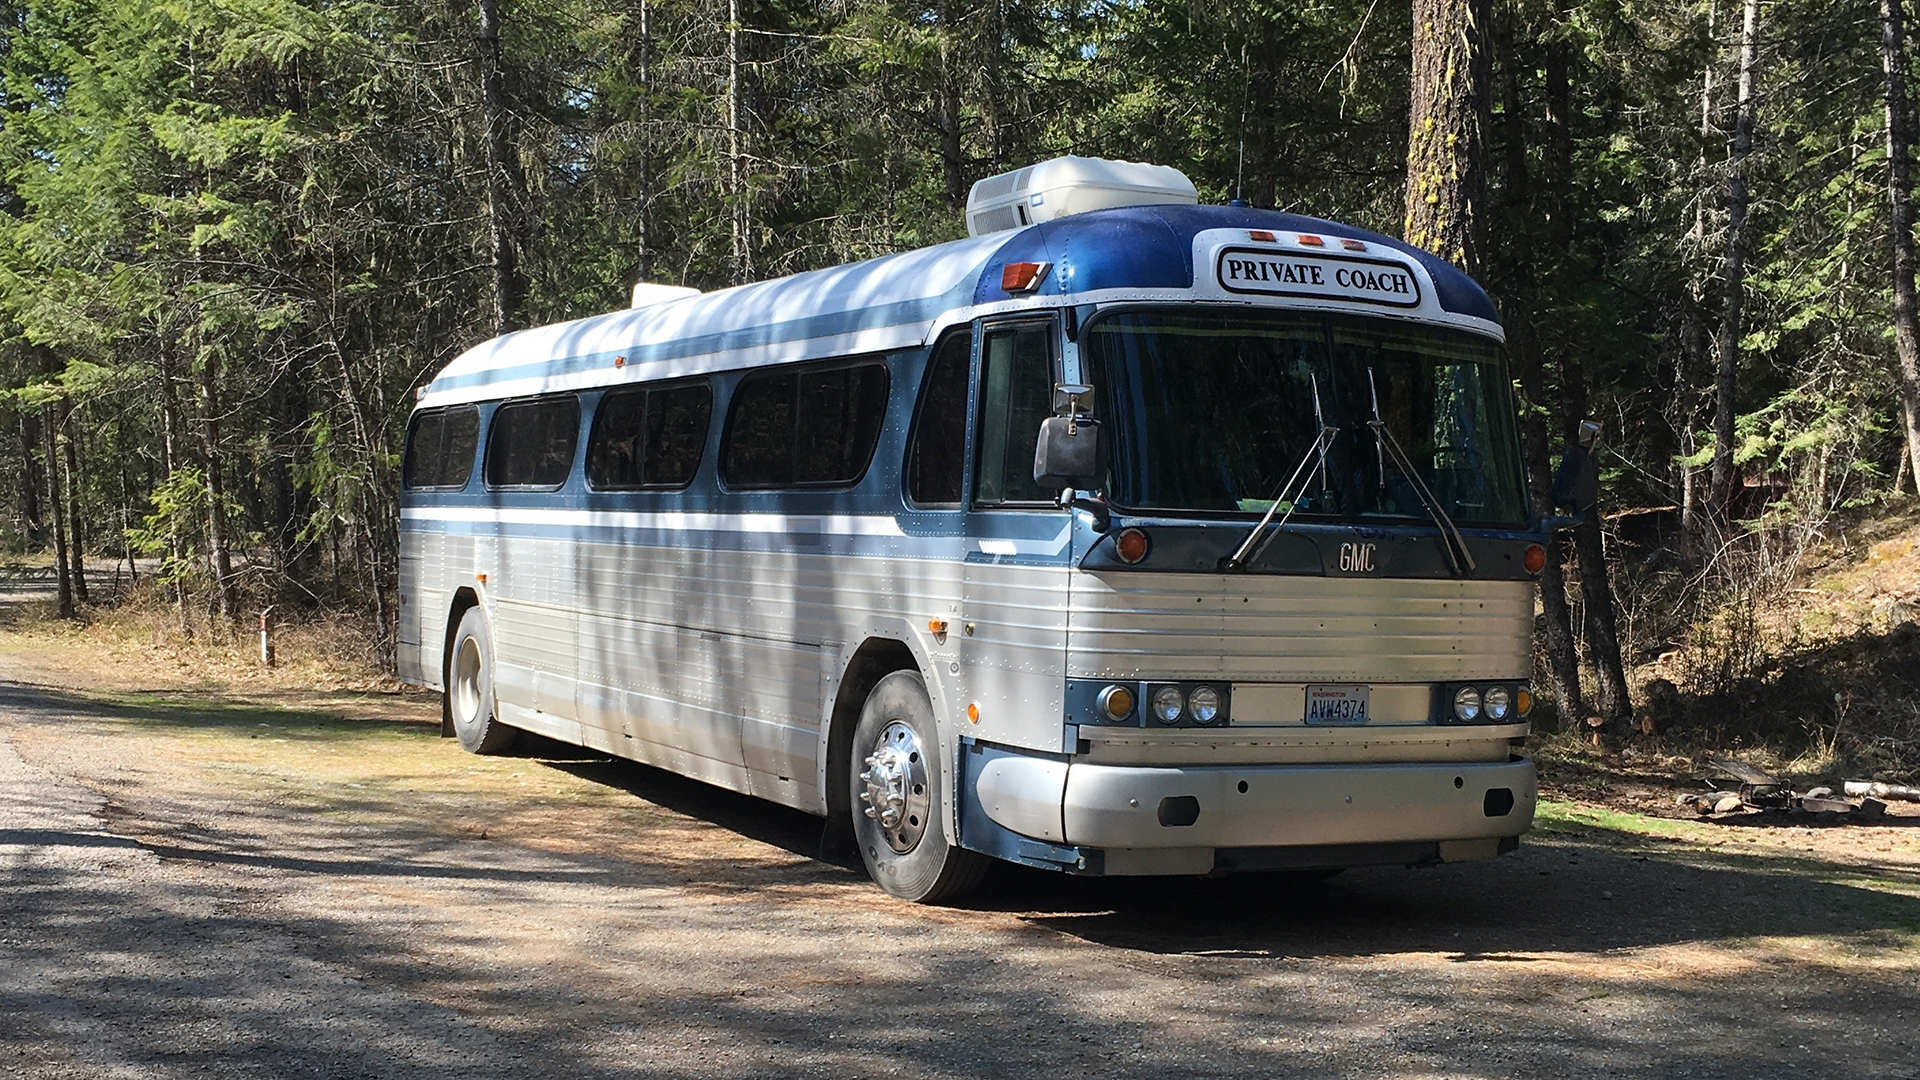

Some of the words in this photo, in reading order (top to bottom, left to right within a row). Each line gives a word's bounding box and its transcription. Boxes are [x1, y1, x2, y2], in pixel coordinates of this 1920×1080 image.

[1227, 259, 1325, 286] PRIVATE
[1335, 268, 1410, 294] COACH
[1339, 542, 1377, 572] GMC
[1310, 700, 1365, 719] AVW4374
